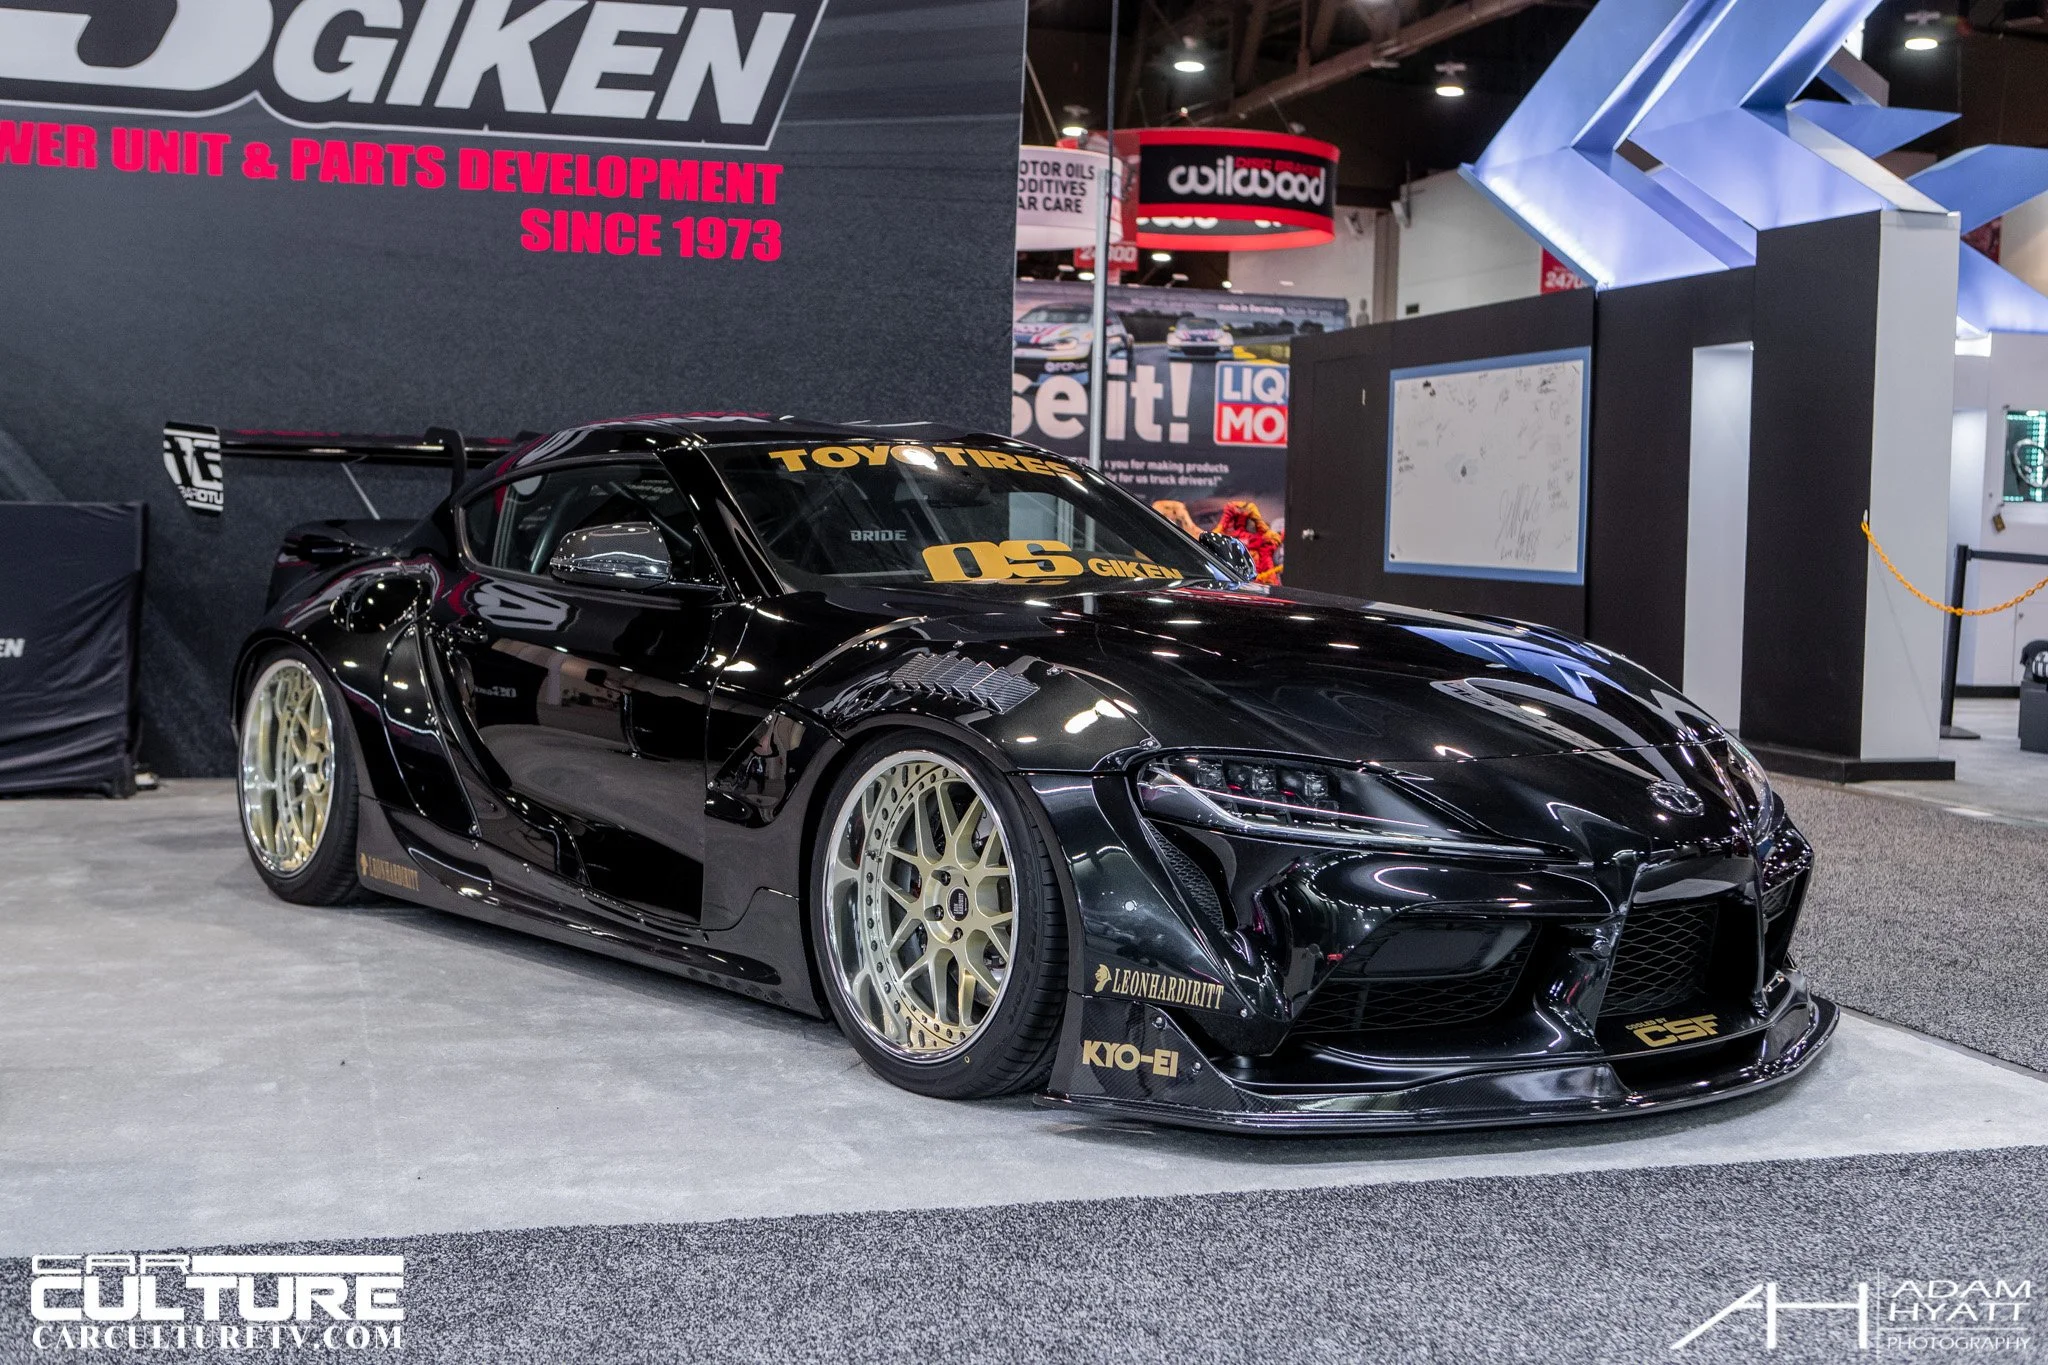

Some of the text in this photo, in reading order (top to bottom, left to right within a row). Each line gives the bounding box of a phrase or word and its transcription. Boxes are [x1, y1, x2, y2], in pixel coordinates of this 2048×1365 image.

[272, 0, 797, 125] GIKEN
[110, 126, 231, 177] UNIT
[241, 141, 279, 180] &
[290, 137, 447, 190] PARTS
[458, 147, 784, 206] DEVELOPMENT
[1065, 163, 1095, 180] OILS
[1168, 154, 1326, 206] wilwood
[1042, 196, 1083, 213] CARE
[520, 207, 783, 262] SINCE 1973
[1105, 359, 1193, 444] it!
[1221, 407, 1286, 441] MO
[931, 446, 1084, 483] TIRES
[1110, 459, 1129, 471] you
[1130, 458, 1146, 470] for
[1147, 460, 1184, 474] making
[1186, 463, 1230, 474] products
[1119, 473, 1134, 484] for
[1135, 475, 1149, 485] us
[1150, 475, 1176, 485] truck
[850, 530, 908, 542] BRIDE
[1087, 557, 1184, 580] GIKEN
[1111, 967, 1224, 1010] LEONHARDIRITT
[1633, 1014, 1718, 1048] CSF
[1082, 1040, 1179, 1078] KYO-EI
